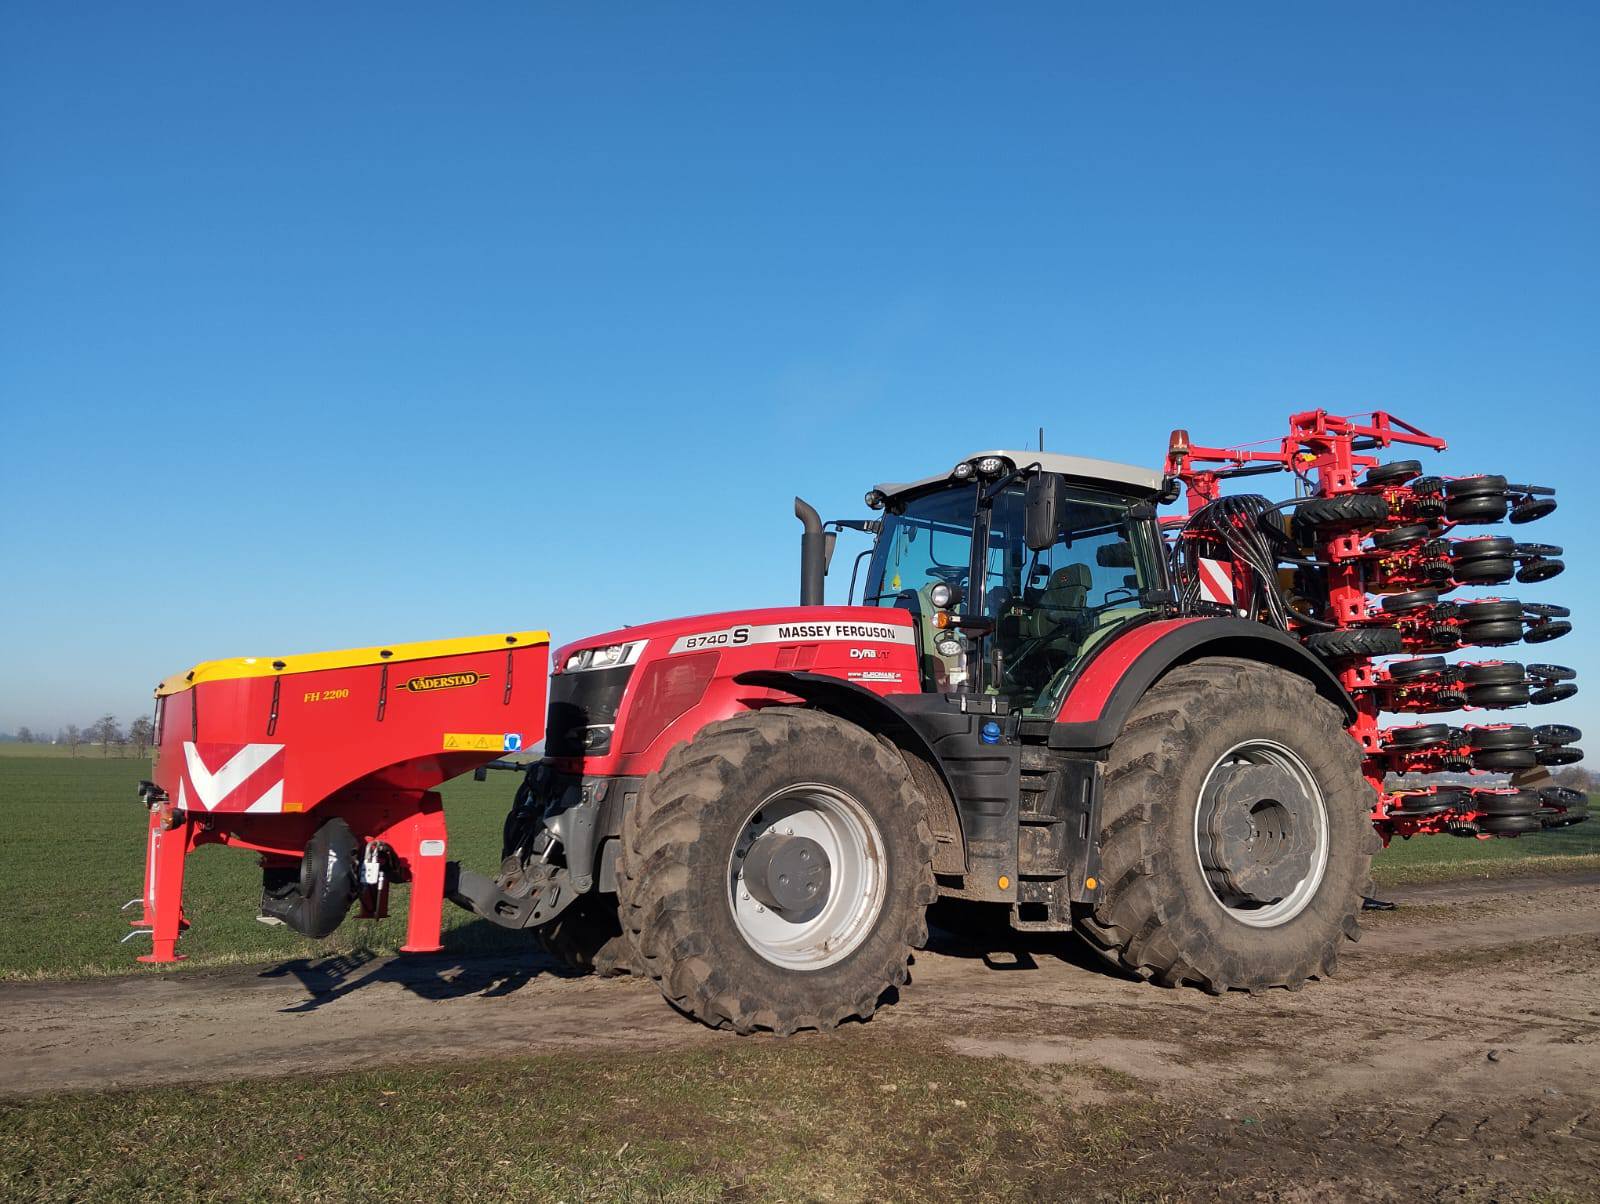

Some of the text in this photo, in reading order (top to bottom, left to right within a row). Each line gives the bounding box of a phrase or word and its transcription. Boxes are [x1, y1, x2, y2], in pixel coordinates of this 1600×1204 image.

[686, 628, 749, 648] 8740 S
[779, 626, 895, 639] MASSEY FERGUSON
[411, 674, 475, 690] VÄDERSTAD
[303, 688, 349, 703] FH 2200
